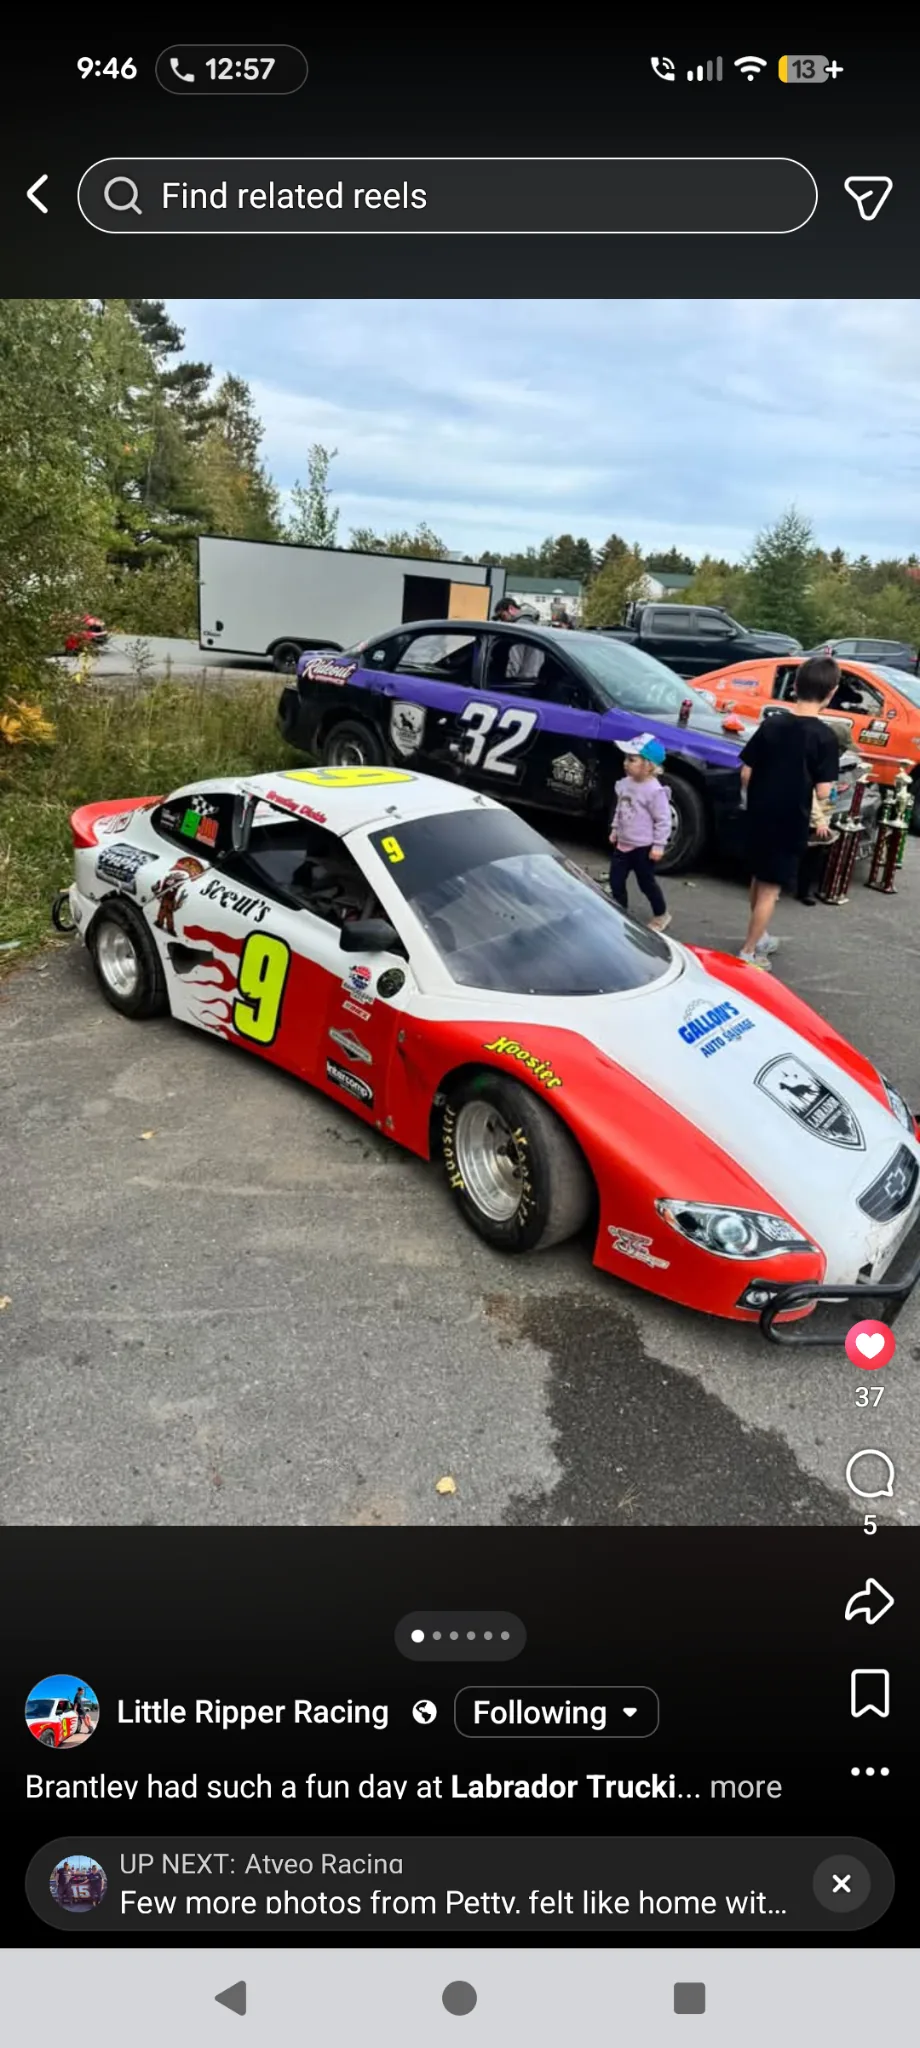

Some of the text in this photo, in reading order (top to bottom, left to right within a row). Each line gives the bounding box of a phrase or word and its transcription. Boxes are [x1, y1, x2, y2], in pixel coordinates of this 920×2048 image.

[302, 658, 357, 680] Rideout
[460, 701, 538, 776] 32
[277, 766, 418, 788] 9
[381, 836, 405, 863] 9
[233, 930, 291, 1046] 9
[677, 1000, 740, 1045] GALLON'S
[700, 1017, 757, 1059] AUTO SALVAGE
[327, 1060, 370, 1098] Intercomp
[482, 1036, 563, 1089] Hoosier
